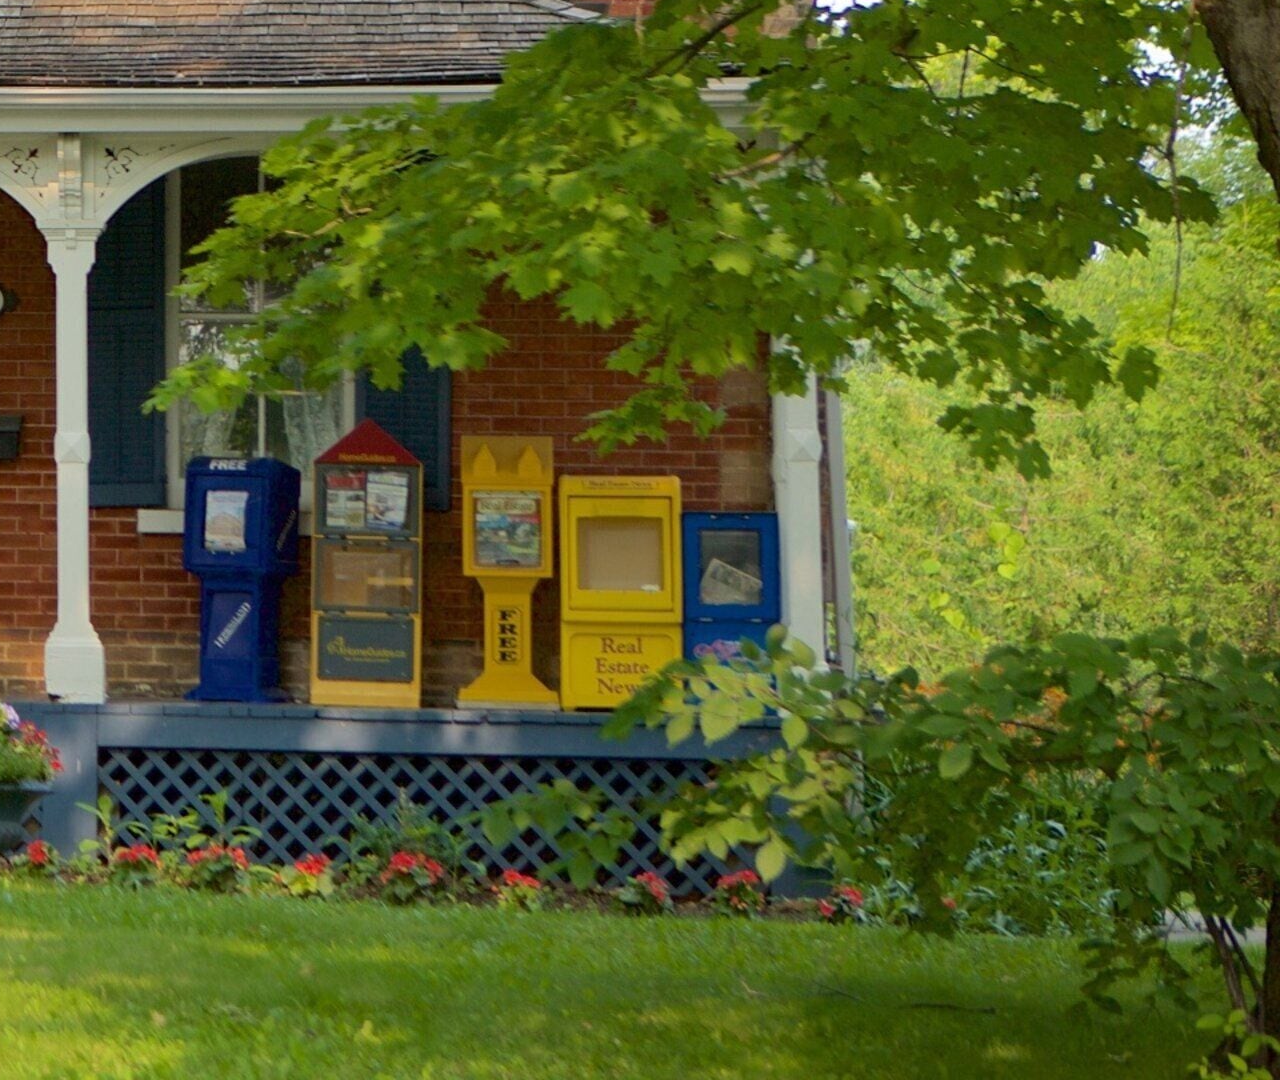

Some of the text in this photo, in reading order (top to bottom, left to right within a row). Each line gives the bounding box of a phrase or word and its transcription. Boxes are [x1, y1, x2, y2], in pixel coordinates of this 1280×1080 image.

[209, 459, 247, 471] FREE
[499, 610, 518, 662] FREE
[601, 636, 643, 654] Real
[595, 657, 649, 674] Estate
[597, 677, 641, 695] New
